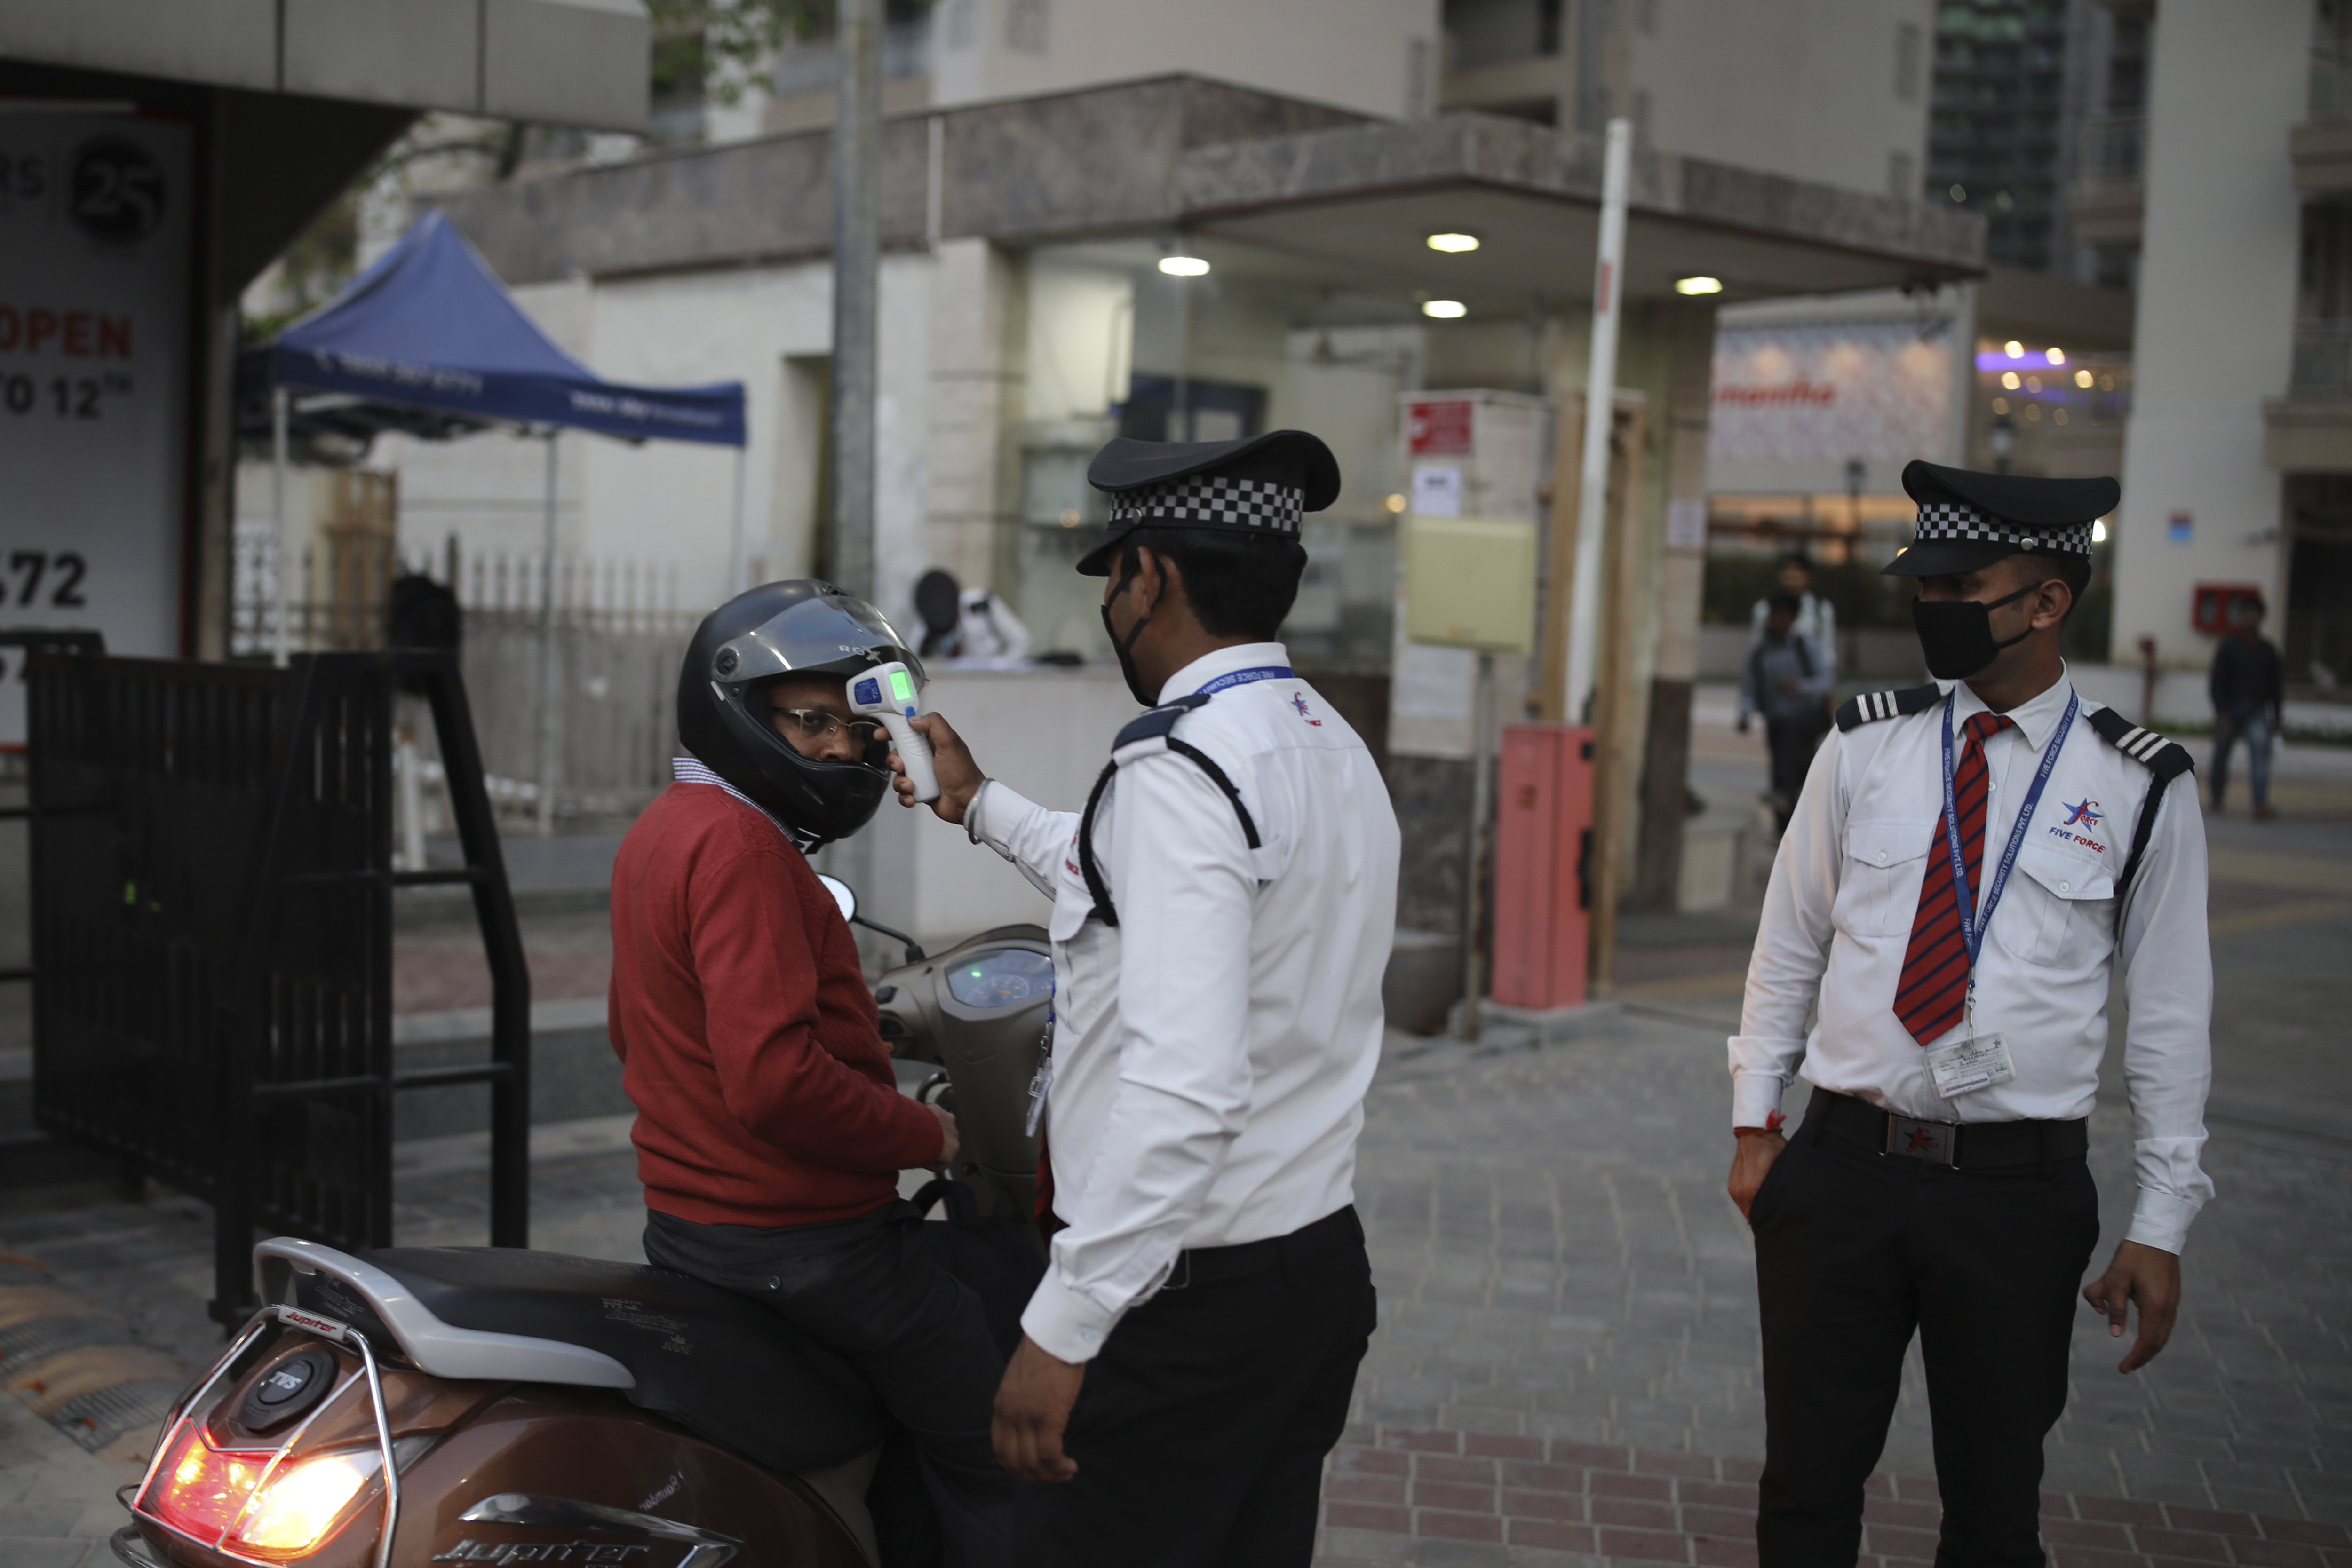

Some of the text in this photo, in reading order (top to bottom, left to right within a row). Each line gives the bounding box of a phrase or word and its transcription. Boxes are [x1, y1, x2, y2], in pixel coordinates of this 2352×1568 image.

[0, 306, 132, 360] OPEN
[0, 549, 87, 608] 72
[2040, 763, 2051, 778] FIVE
[2047, 743, 2059, 764] FORCE
[2055, 716, 2070, 744] SECURITY
[1948, 812, 1959, 849] SOLUTIONS
[2049, 826, 2106, 853] FIVE FORCE
[1984, 895, 1998, 917] FORCE
[1993, 863, 2009, 895] SECURITY
[2003, 829, 2022, 865] SOLUTIONS
[286, 1311, 337, 1332] Jupiter
[268, 1370, 302, 1389] TVS
[431, 1538, 650, 1566] Jupiter
